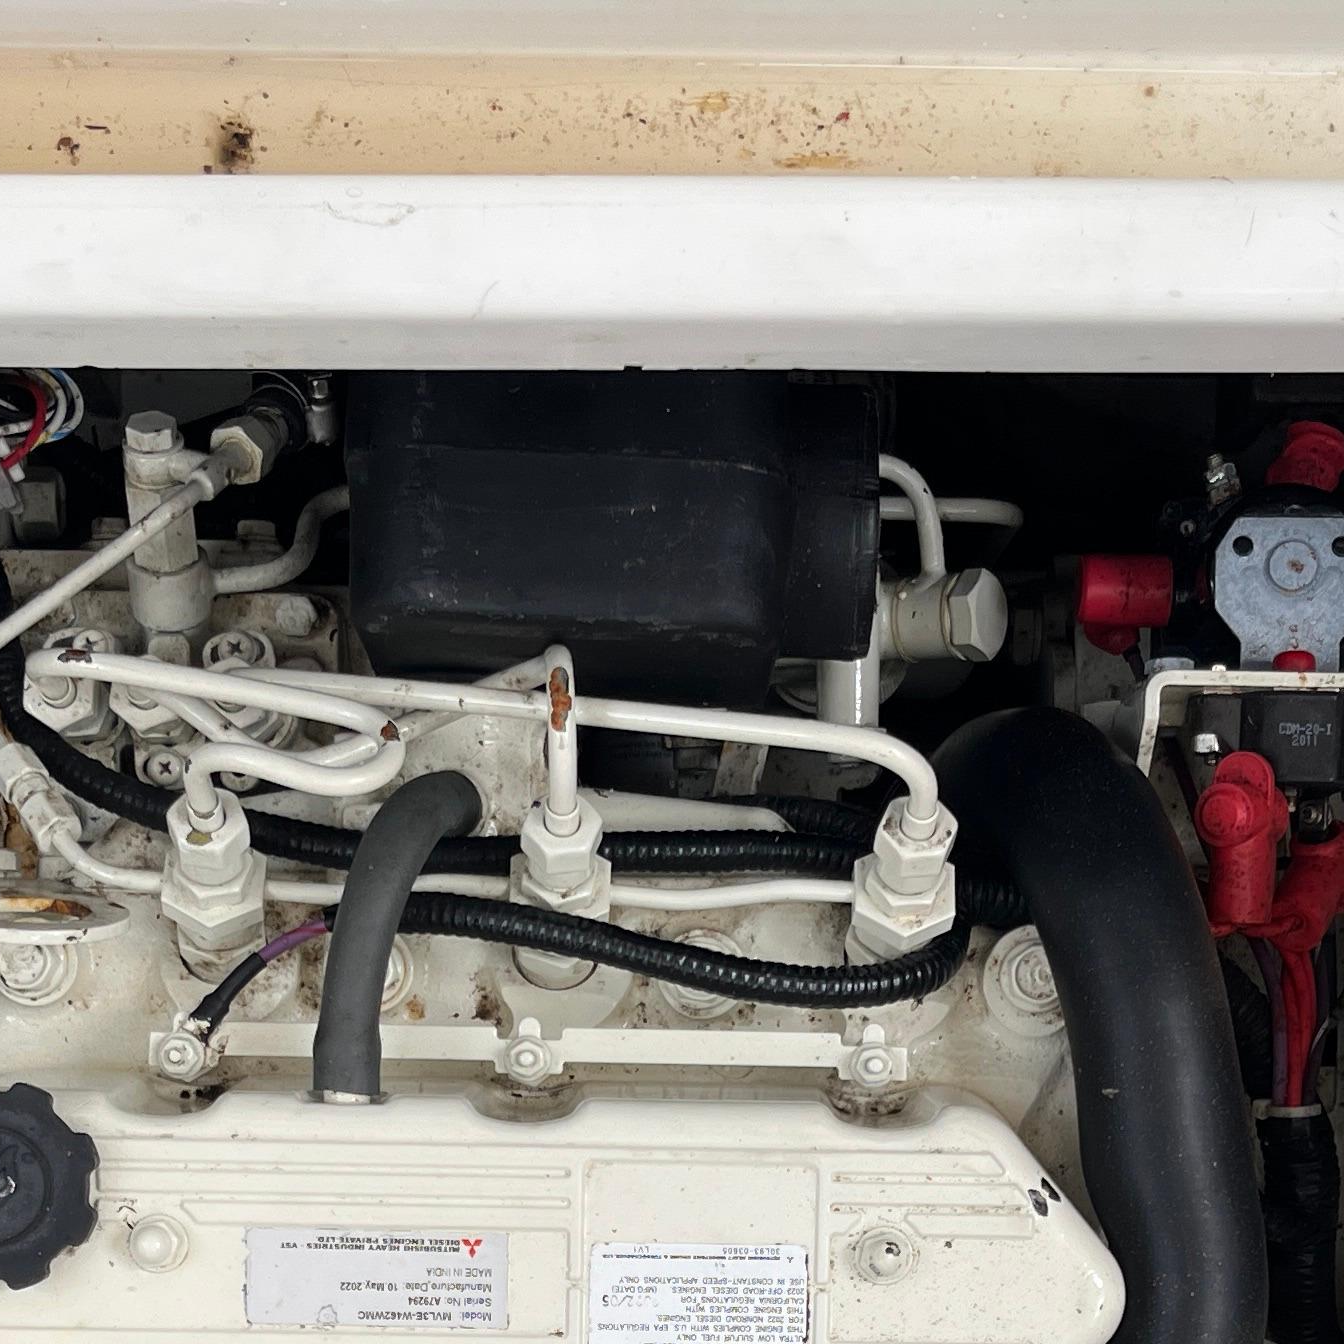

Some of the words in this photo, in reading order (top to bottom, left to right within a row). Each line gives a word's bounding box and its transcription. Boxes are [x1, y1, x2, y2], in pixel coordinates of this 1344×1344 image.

[426, 1268, 450, 1277] INDIA
[454, 1268, 462, 1276] IN
[465, 1268, 492, 1277] MADE
[408, 1296, 441, 1306] A79294
[444, 1298, 460, 1306] No:
[464, 1298, 492, 1307] Serial
[358, 1311, 451, 1320] MVL3E-W462WMC
[459, 1312, 491, 1321] Model:
